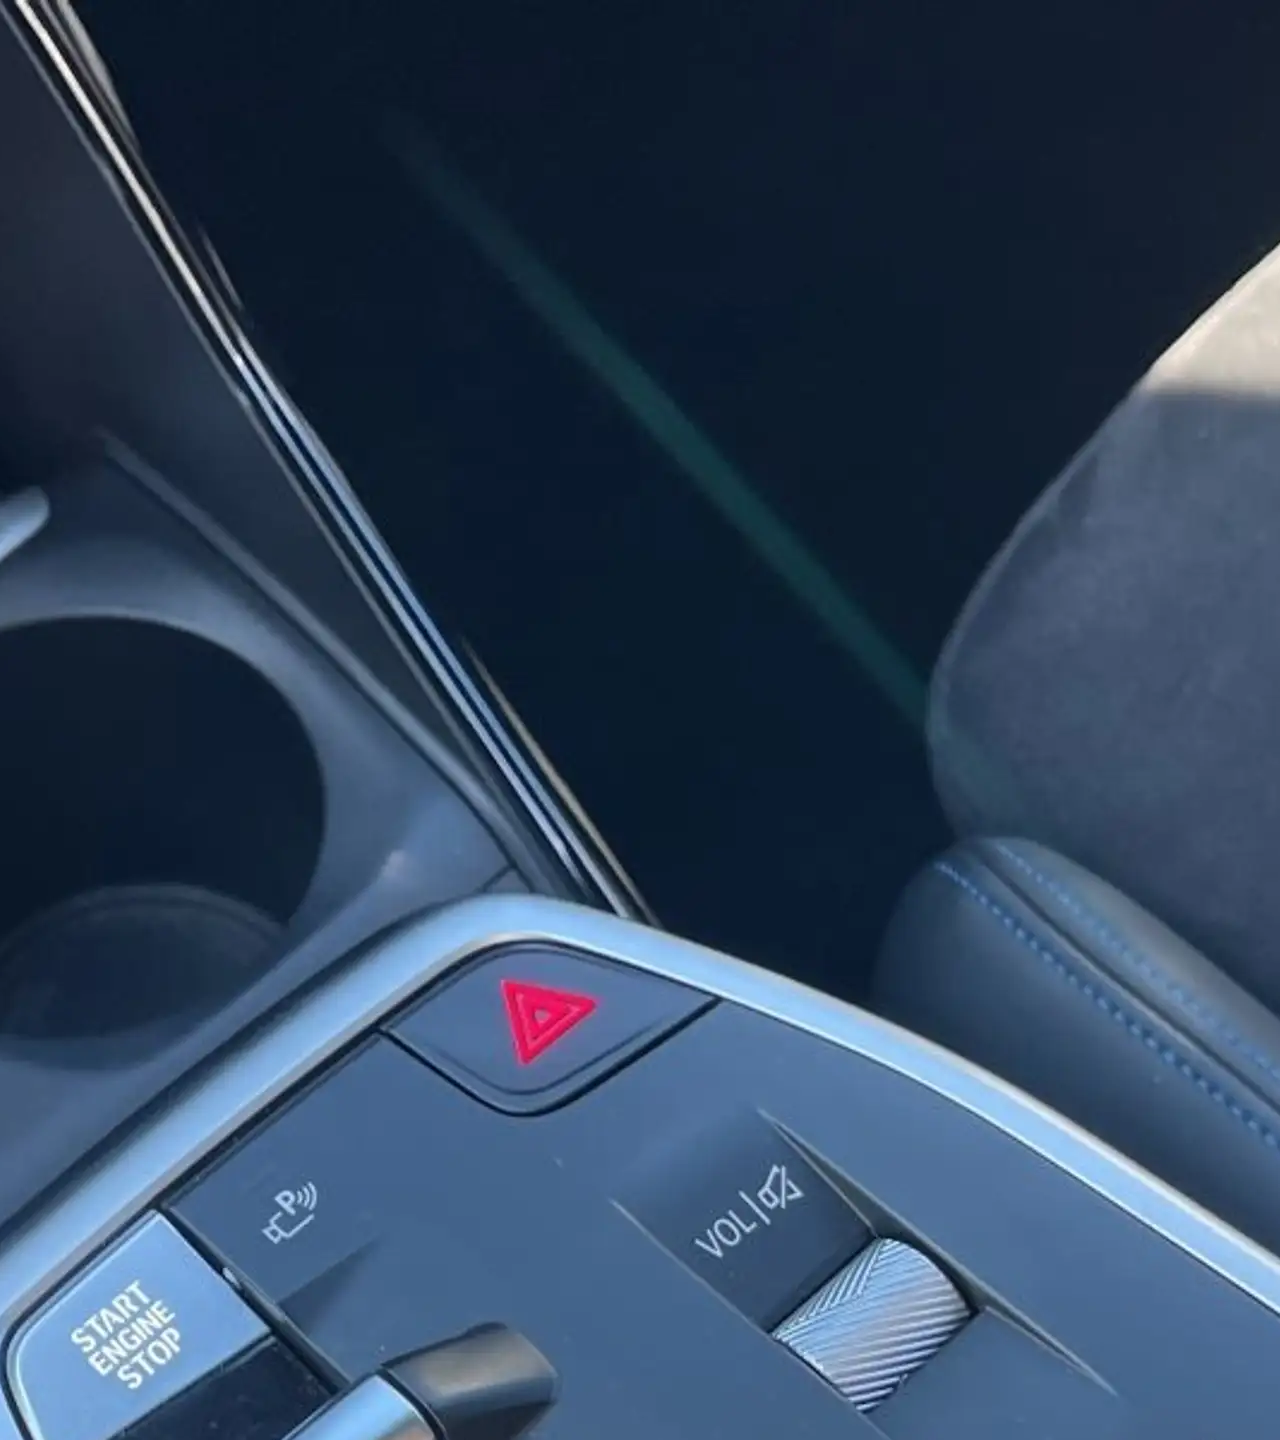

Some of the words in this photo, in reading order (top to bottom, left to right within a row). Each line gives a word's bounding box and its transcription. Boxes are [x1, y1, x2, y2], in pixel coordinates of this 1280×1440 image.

[694, 1209, 758, 1258] VOL
[71, 1279, 151, 1353] START
[88, 1300, 176, 1376] ENGINE
[117, 1327, 181, 1389] STOP
